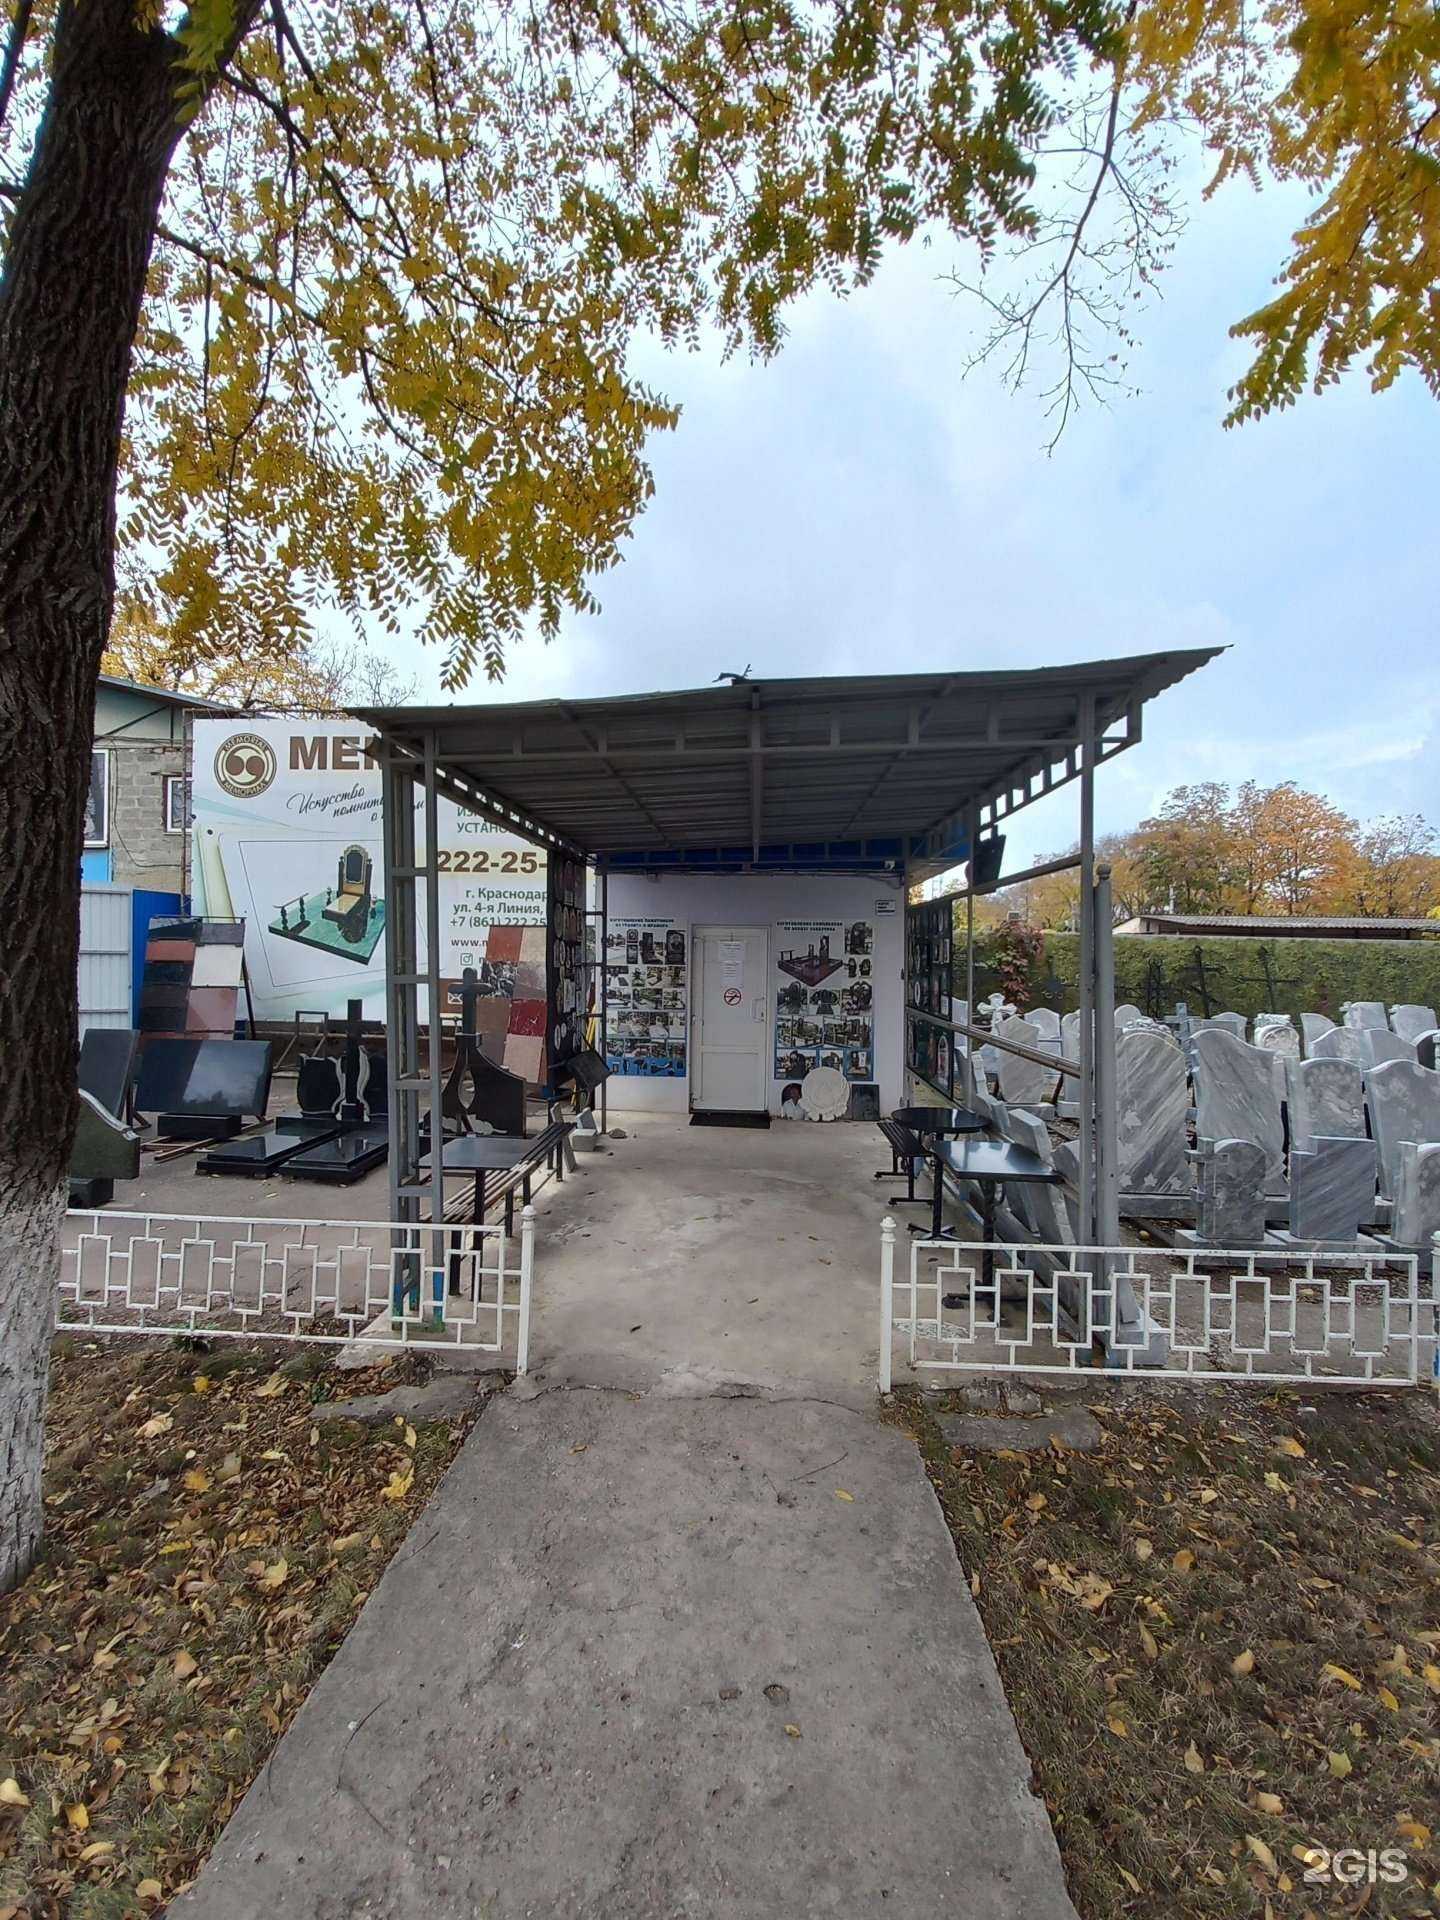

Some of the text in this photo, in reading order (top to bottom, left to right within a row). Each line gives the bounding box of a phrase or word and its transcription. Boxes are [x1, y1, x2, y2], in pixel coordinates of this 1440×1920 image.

[286, 782, 365, 815] Искусство
[465, 888, 548, 901] г. Краснодар
[453, 902, 544, 915] ул. 4-я Линия,
[450, 916, 466, 927] +7
[469, 916, 501, 928] (861)
